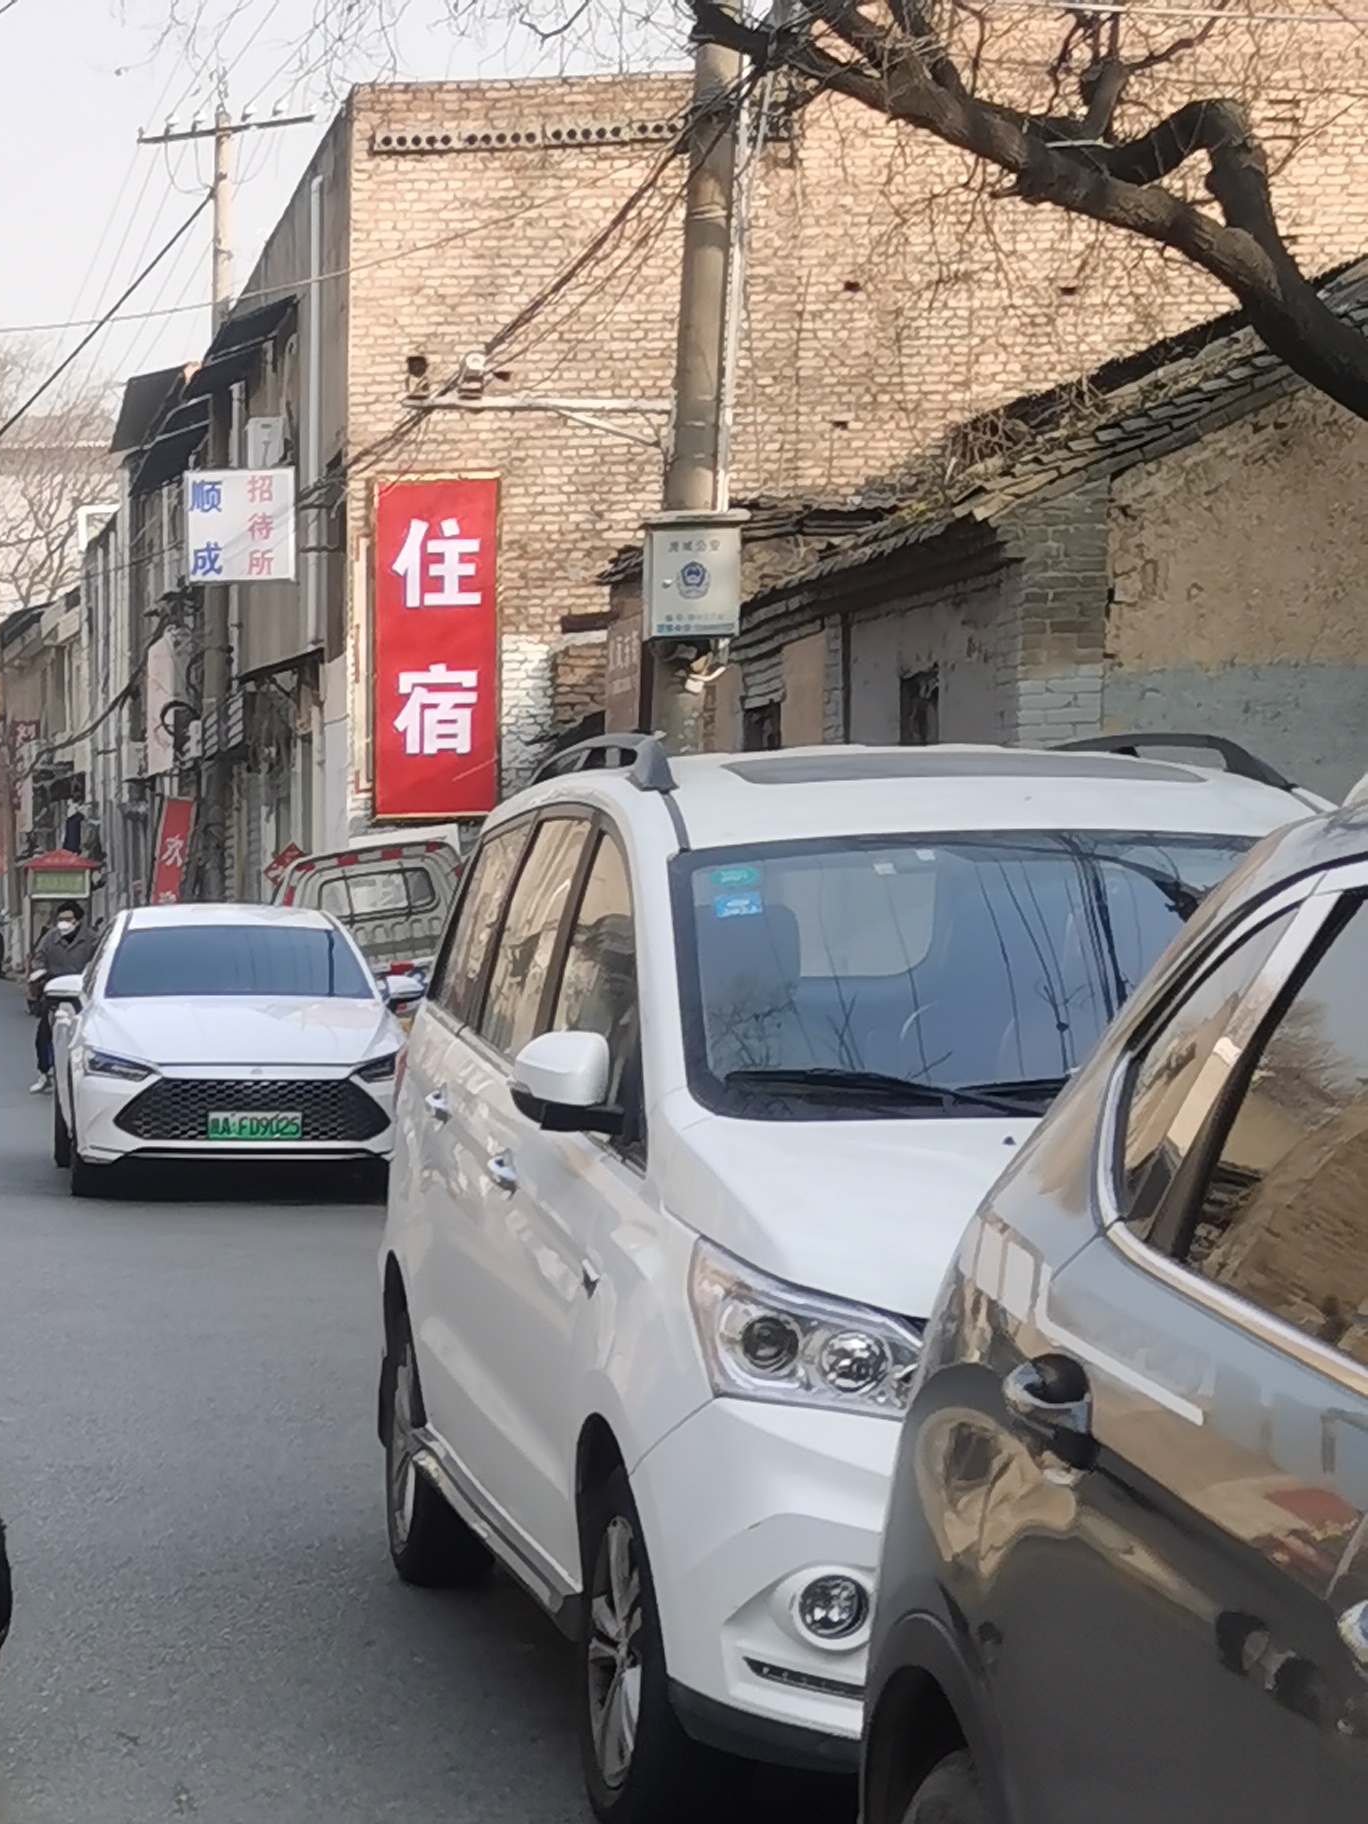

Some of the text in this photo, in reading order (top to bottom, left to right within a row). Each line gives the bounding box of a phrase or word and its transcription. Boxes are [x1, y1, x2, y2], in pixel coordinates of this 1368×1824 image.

[189, 479, 223, 577] 顺成
[246, 474, 275, 576] 招待所
[391, 517, 482, 756] 住宿
